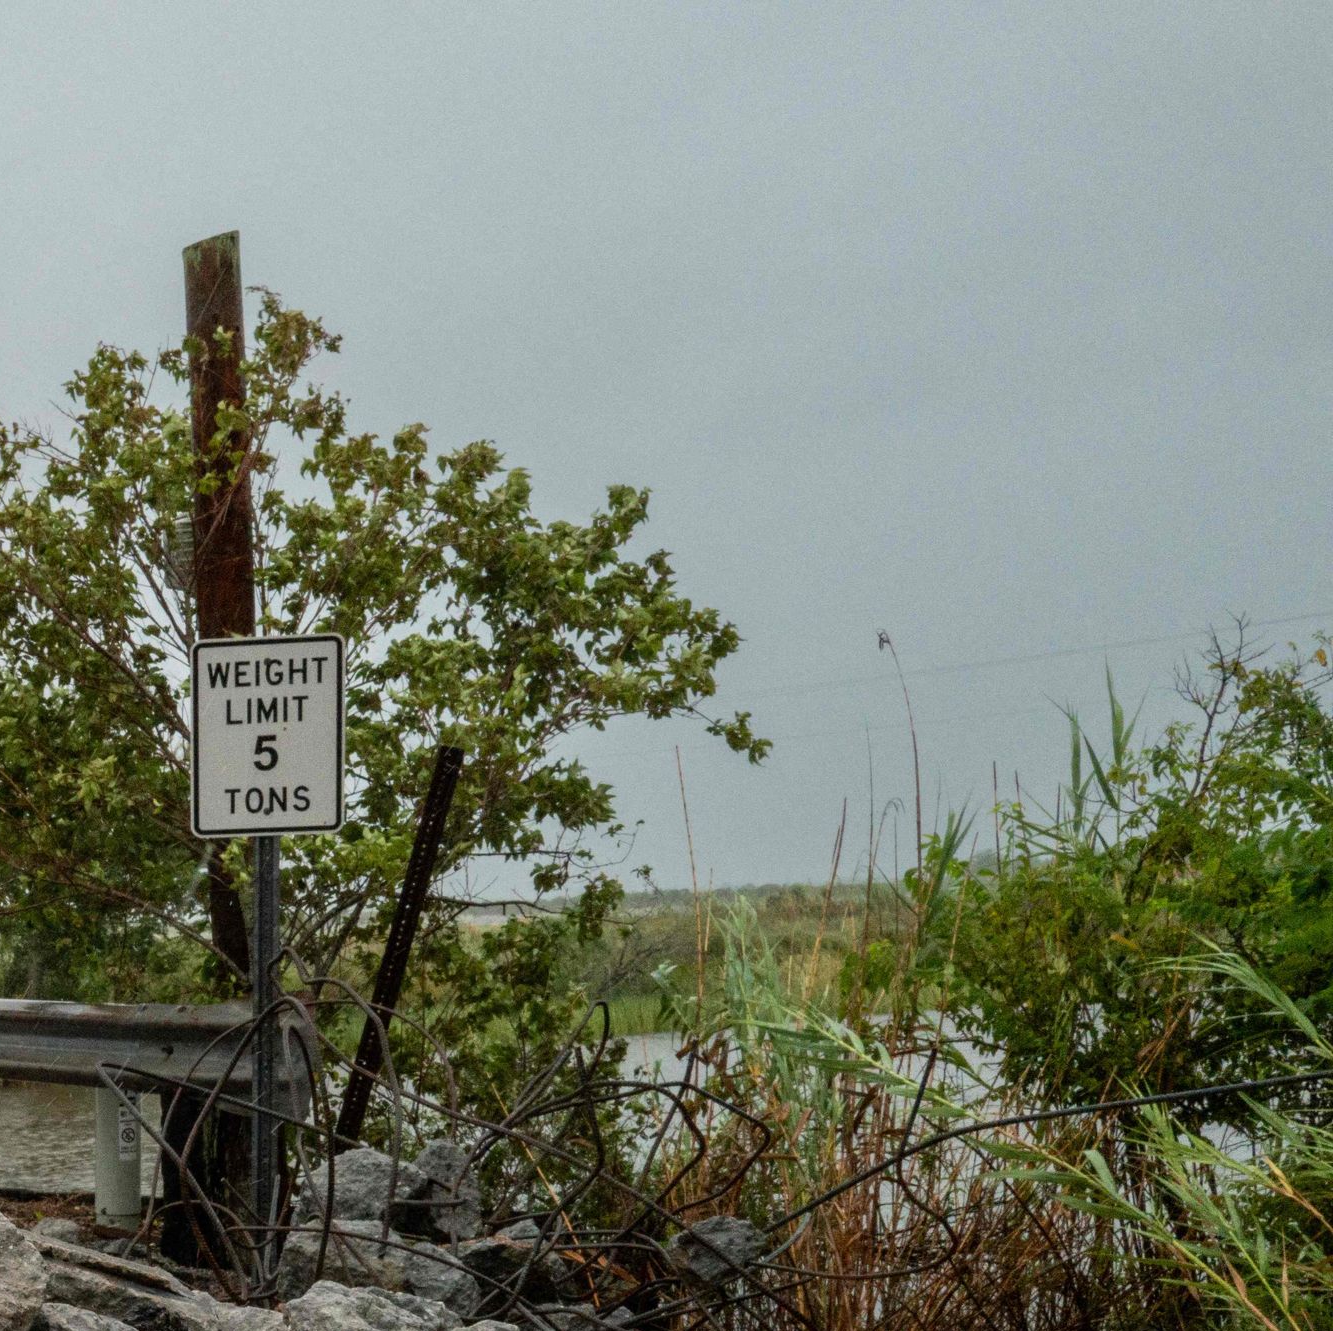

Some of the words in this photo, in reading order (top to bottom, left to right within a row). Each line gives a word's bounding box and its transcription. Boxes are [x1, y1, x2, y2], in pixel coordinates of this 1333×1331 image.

[207, 657, 328, 688] WEIGHT
[226, 696, 308, 725] LIMIT
[253, 735, 279, 771] 5
[225, 785, 310, 814] TONS
